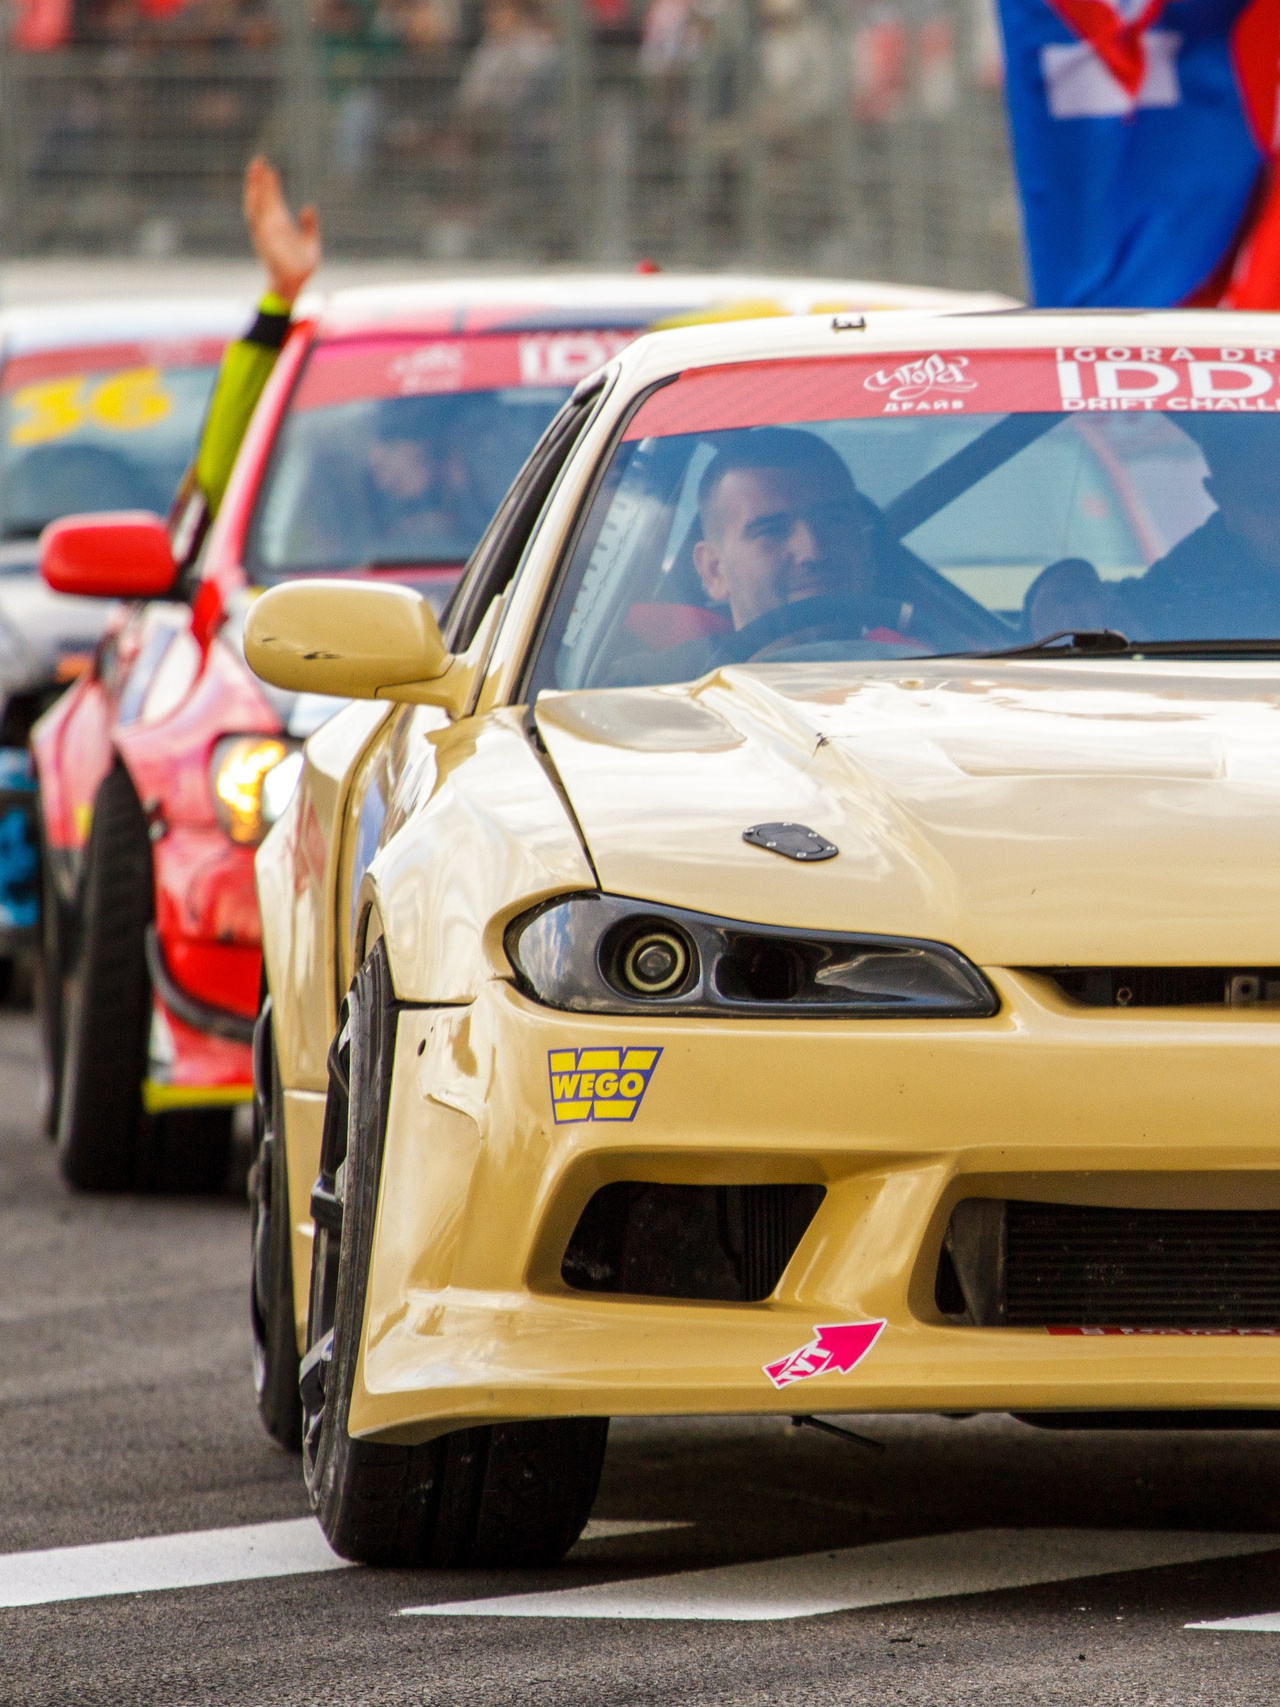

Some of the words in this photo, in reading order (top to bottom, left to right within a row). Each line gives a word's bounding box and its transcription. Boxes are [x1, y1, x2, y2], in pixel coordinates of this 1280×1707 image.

[1056, 347, 1195, 363] IGORA
[7, 366, 169, 446] 36
[883, 399, 964, 412] ДРАЙВ
[1061, 397, 1158, 411] DRIFT
[551, 1071, 645, 1100] WEGO
